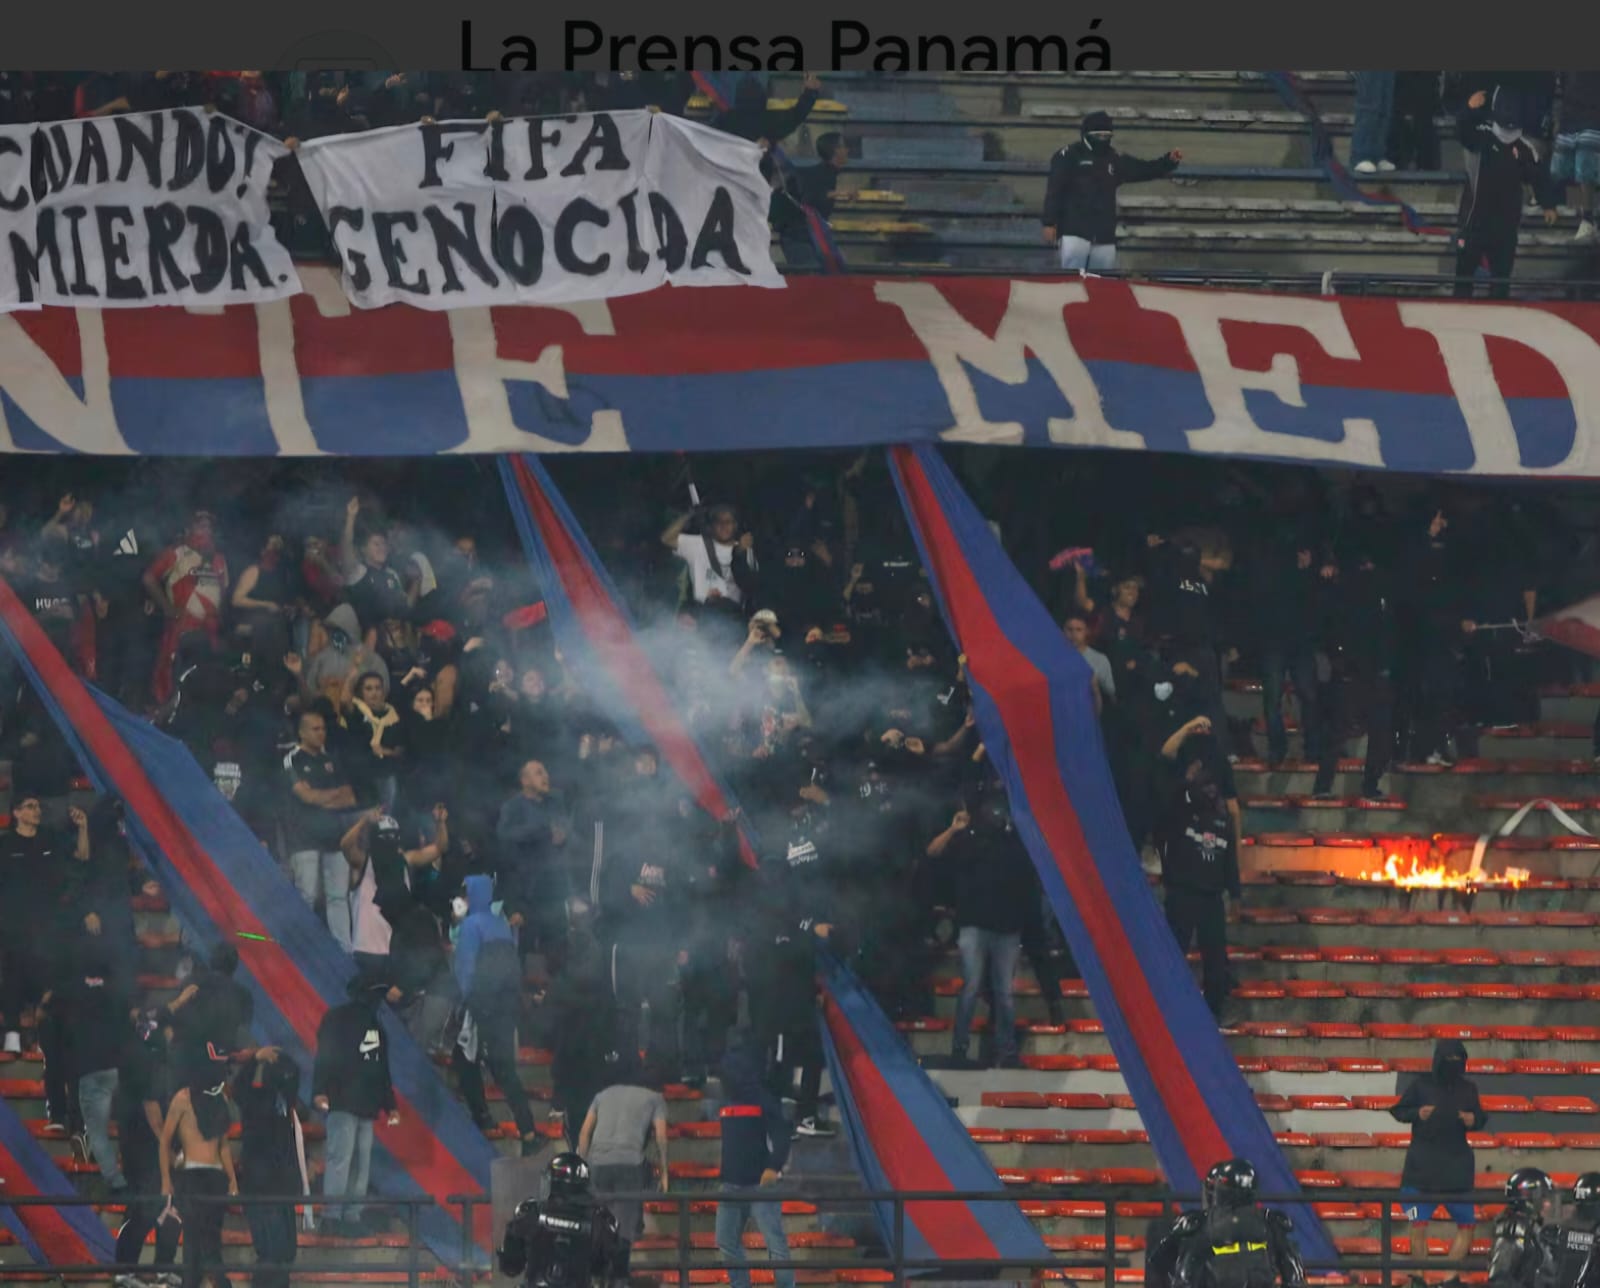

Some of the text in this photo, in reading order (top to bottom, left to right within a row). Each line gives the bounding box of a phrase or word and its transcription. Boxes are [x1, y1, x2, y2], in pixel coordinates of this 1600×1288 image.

[418, 113, 630, 188] FIFA
[9, 201, 287, 302] MIERDA.
[329, 186, 752, 295] GENOCIDA
[874, 280, 1600, 477] MED
